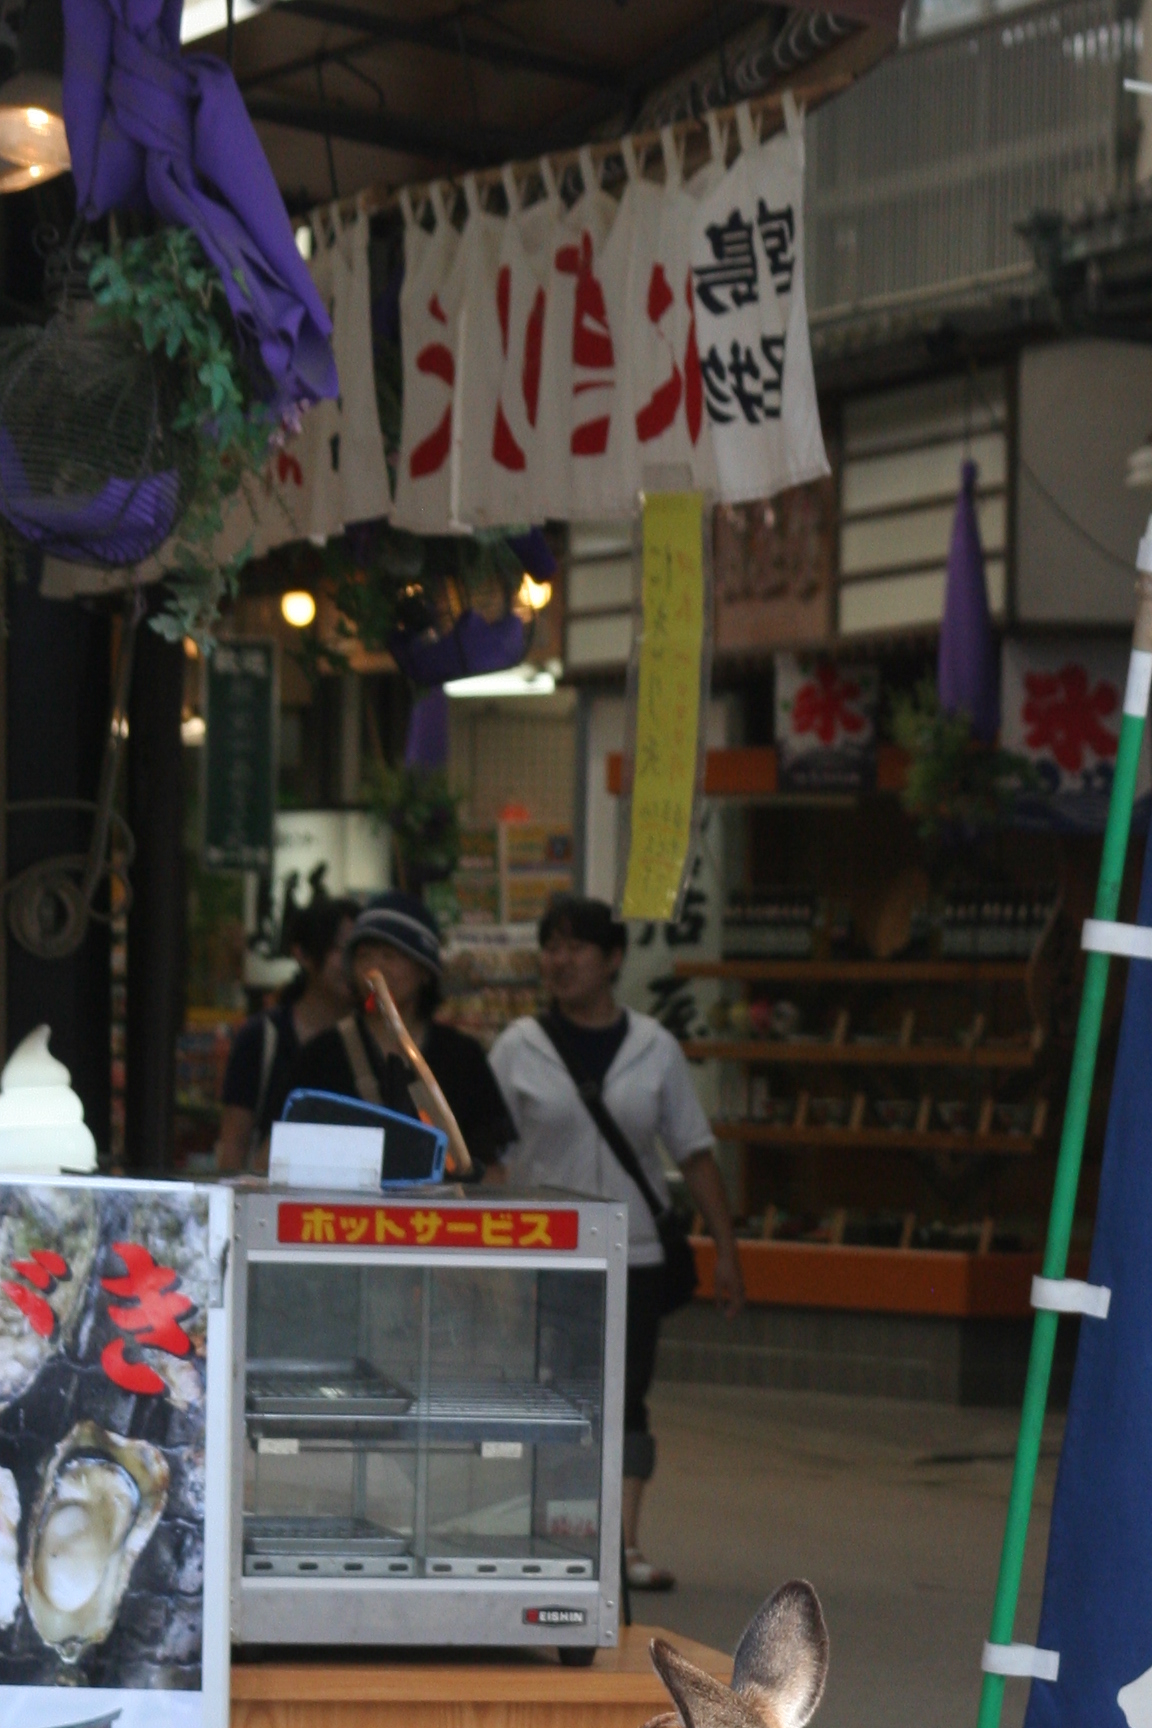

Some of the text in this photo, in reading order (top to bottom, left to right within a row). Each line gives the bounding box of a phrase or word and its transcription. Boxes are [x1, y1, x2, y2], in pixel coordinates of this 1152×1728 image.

[302, 1208, 553, 1246] ホットサービス
